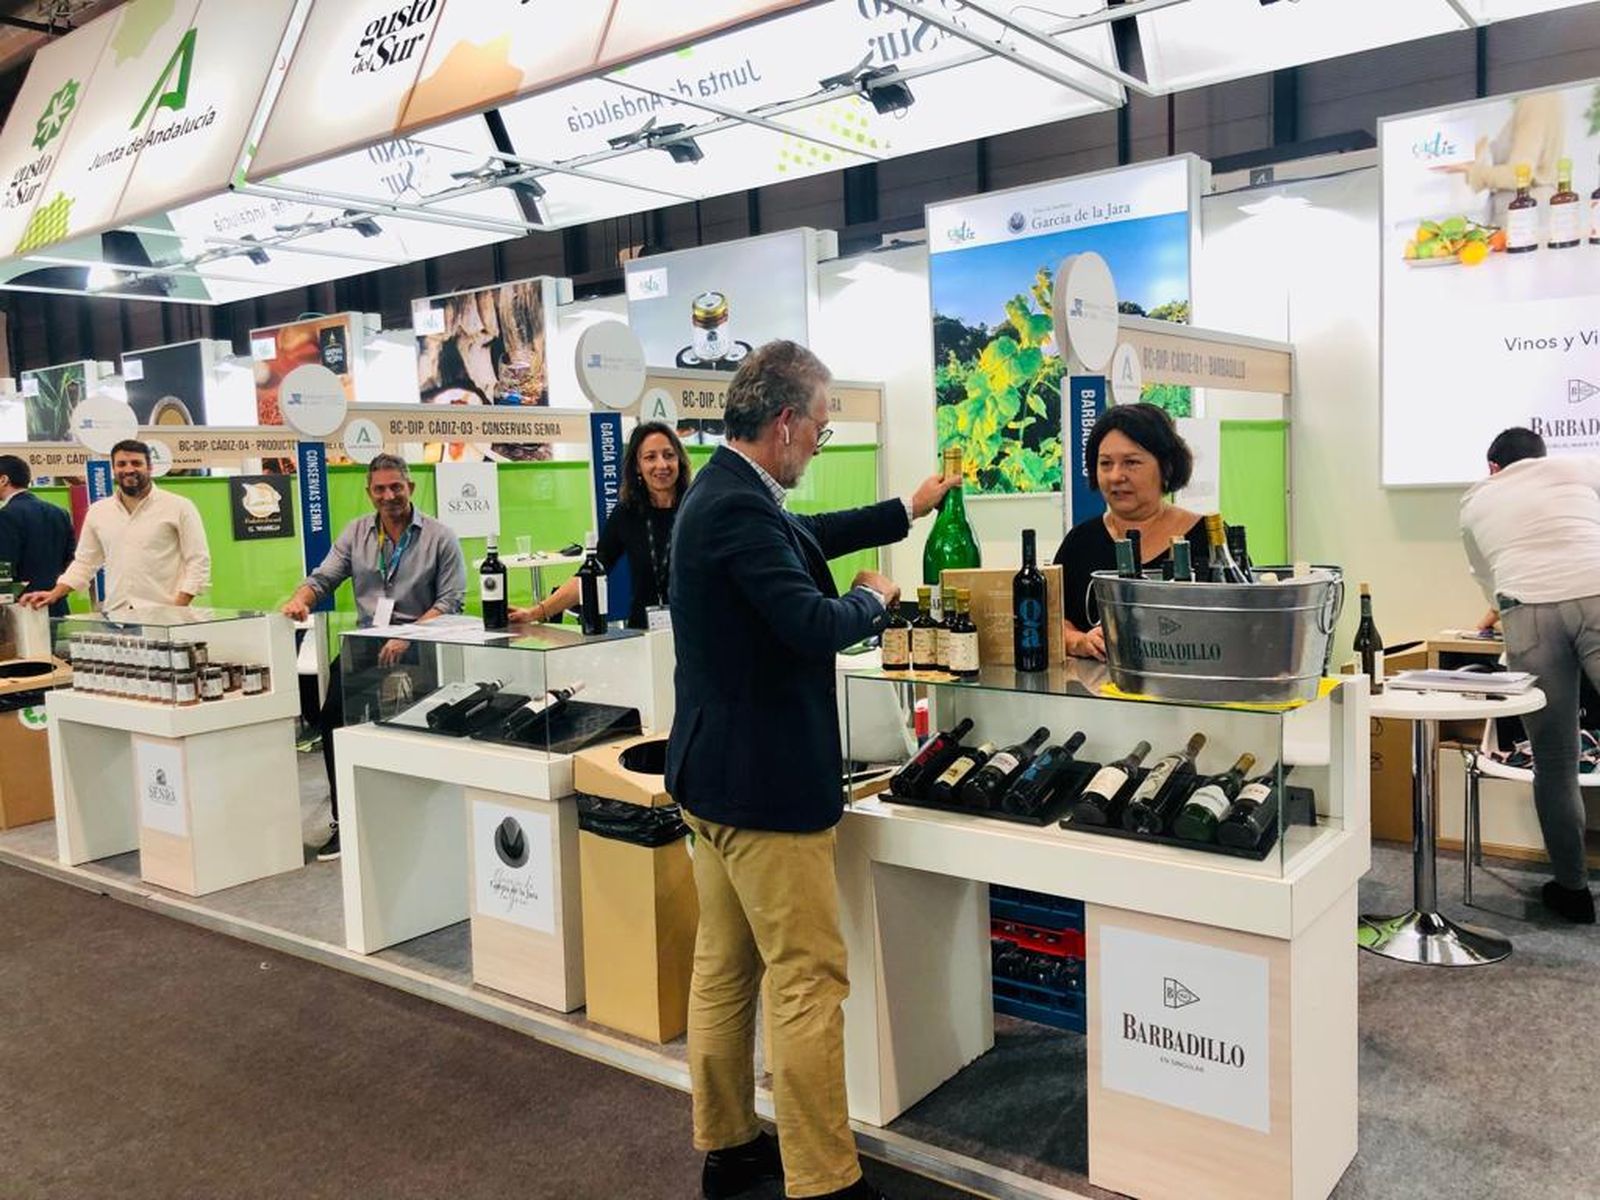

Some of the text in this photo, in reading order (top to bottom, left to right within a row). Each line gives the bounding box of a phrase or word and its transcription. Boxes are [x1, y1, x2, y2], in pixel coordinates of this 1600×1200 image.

[354, 0, 436, 58] gusto
[370, 34, 425, 72] Sur
[87, 105, 217, 171] Junta de Andalucía
[1031, 202, 1131, 230] García de la Jara
[1504, 336, 1557, 351] Vinos
[1563, 336, 1574, 352] y
[482, 421, 532, 436] CONSERVAS
[534, 422, 561, 436] SENRA
[1080, 389, 1097, 477] BARBA
[1531, 416, 1600, 437] BARBAD
[600, 422, 618, 519] GARCÍA DE LA JA
[306, 449, 323, 532] CONSERVAS SENRA
[448, 499, 490, 512] SENRA
[1132, 635, 1221, 661] BARBADILLO
[1122, 1012, 1246, 1069] BARBADILLO
